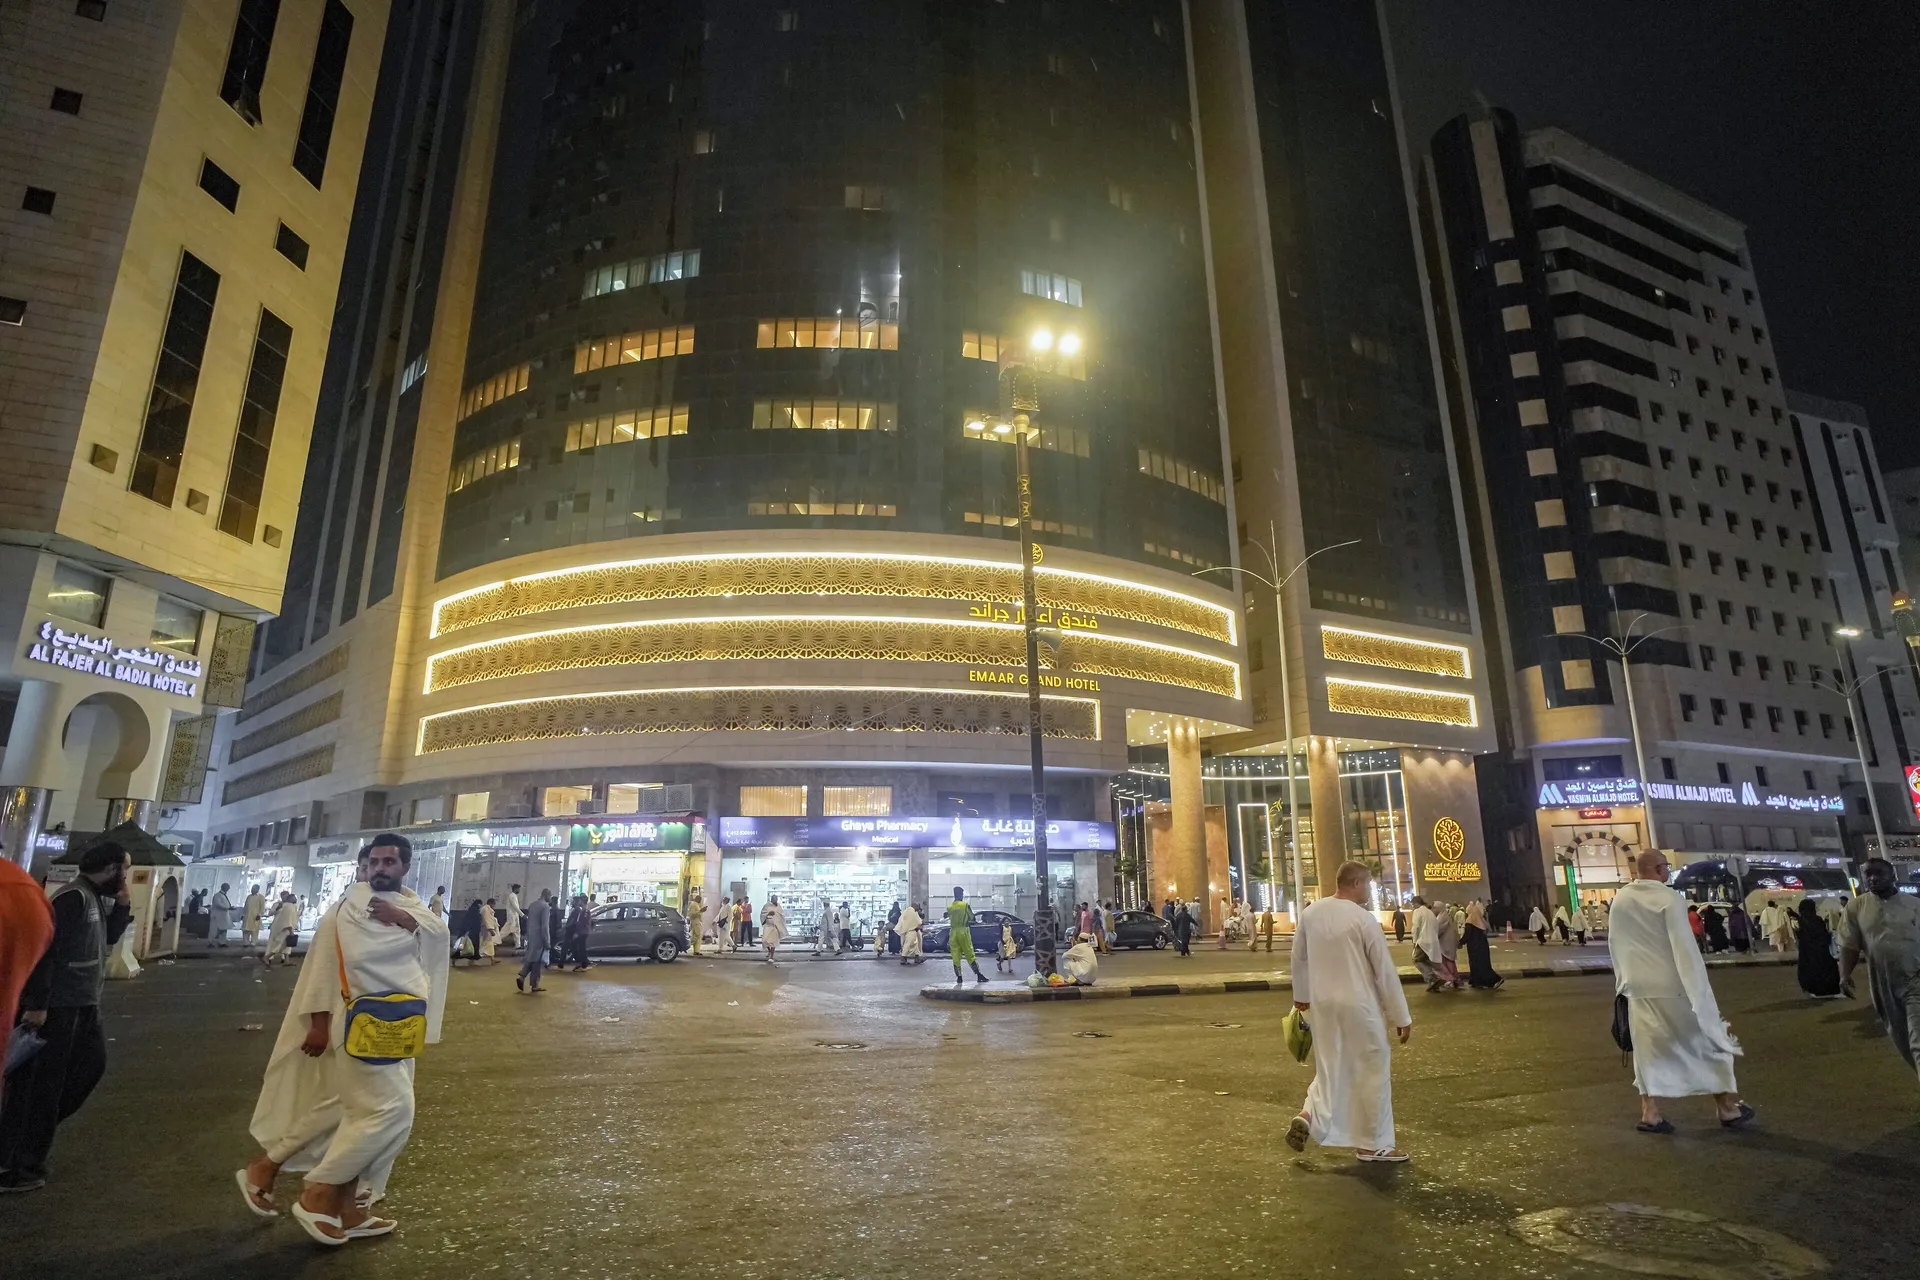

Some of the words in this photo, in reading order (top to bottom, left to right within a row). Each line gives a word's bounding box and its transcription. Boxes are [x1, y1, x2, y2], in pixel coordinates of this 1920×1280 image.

[968, 603, 1010, 622] جراند
[1014, 605, 1052, 624] اعار
[1057, 611, 1098, 629] فندق
[52, 628, 113, 655] البديع
[112, 647, 163, 667] الفجر
[164, 654, 202, 678] فندق
[29, 643, 50, 662] AL
[52, 649, 94, 673] FAJER
[94, 660, 112, 677] AL
[114, 664, 151, 687] BADIA
[152, 674, 187, 695] HOTEL
[188, 684, 197, 698] 4
[969, 670, 1014, 684] EMAAR
[1019, 673, 1062, 688] GAND
[1065, 677, 1101, 692] HOTEL
[1616, 778, 1637, 791] فندق
[1675, 784, 1708, 802] ALMAJD
[1708, 787, 1737, 804] HOTEL
[1567, 793, 1591, 804] YASMIN
[1592, 793, 1617, 803] ALMAJD
[1617, 792, 1639, 802] HOTEL
[1821, 795, 1844, 811] فندق
[841, 819, 874, 832] Ghaya
[876, 819, 928, 833] Pharmacy
[981, 819, 1014, 836] غاية
[871, 835, 899, 843] Medical
